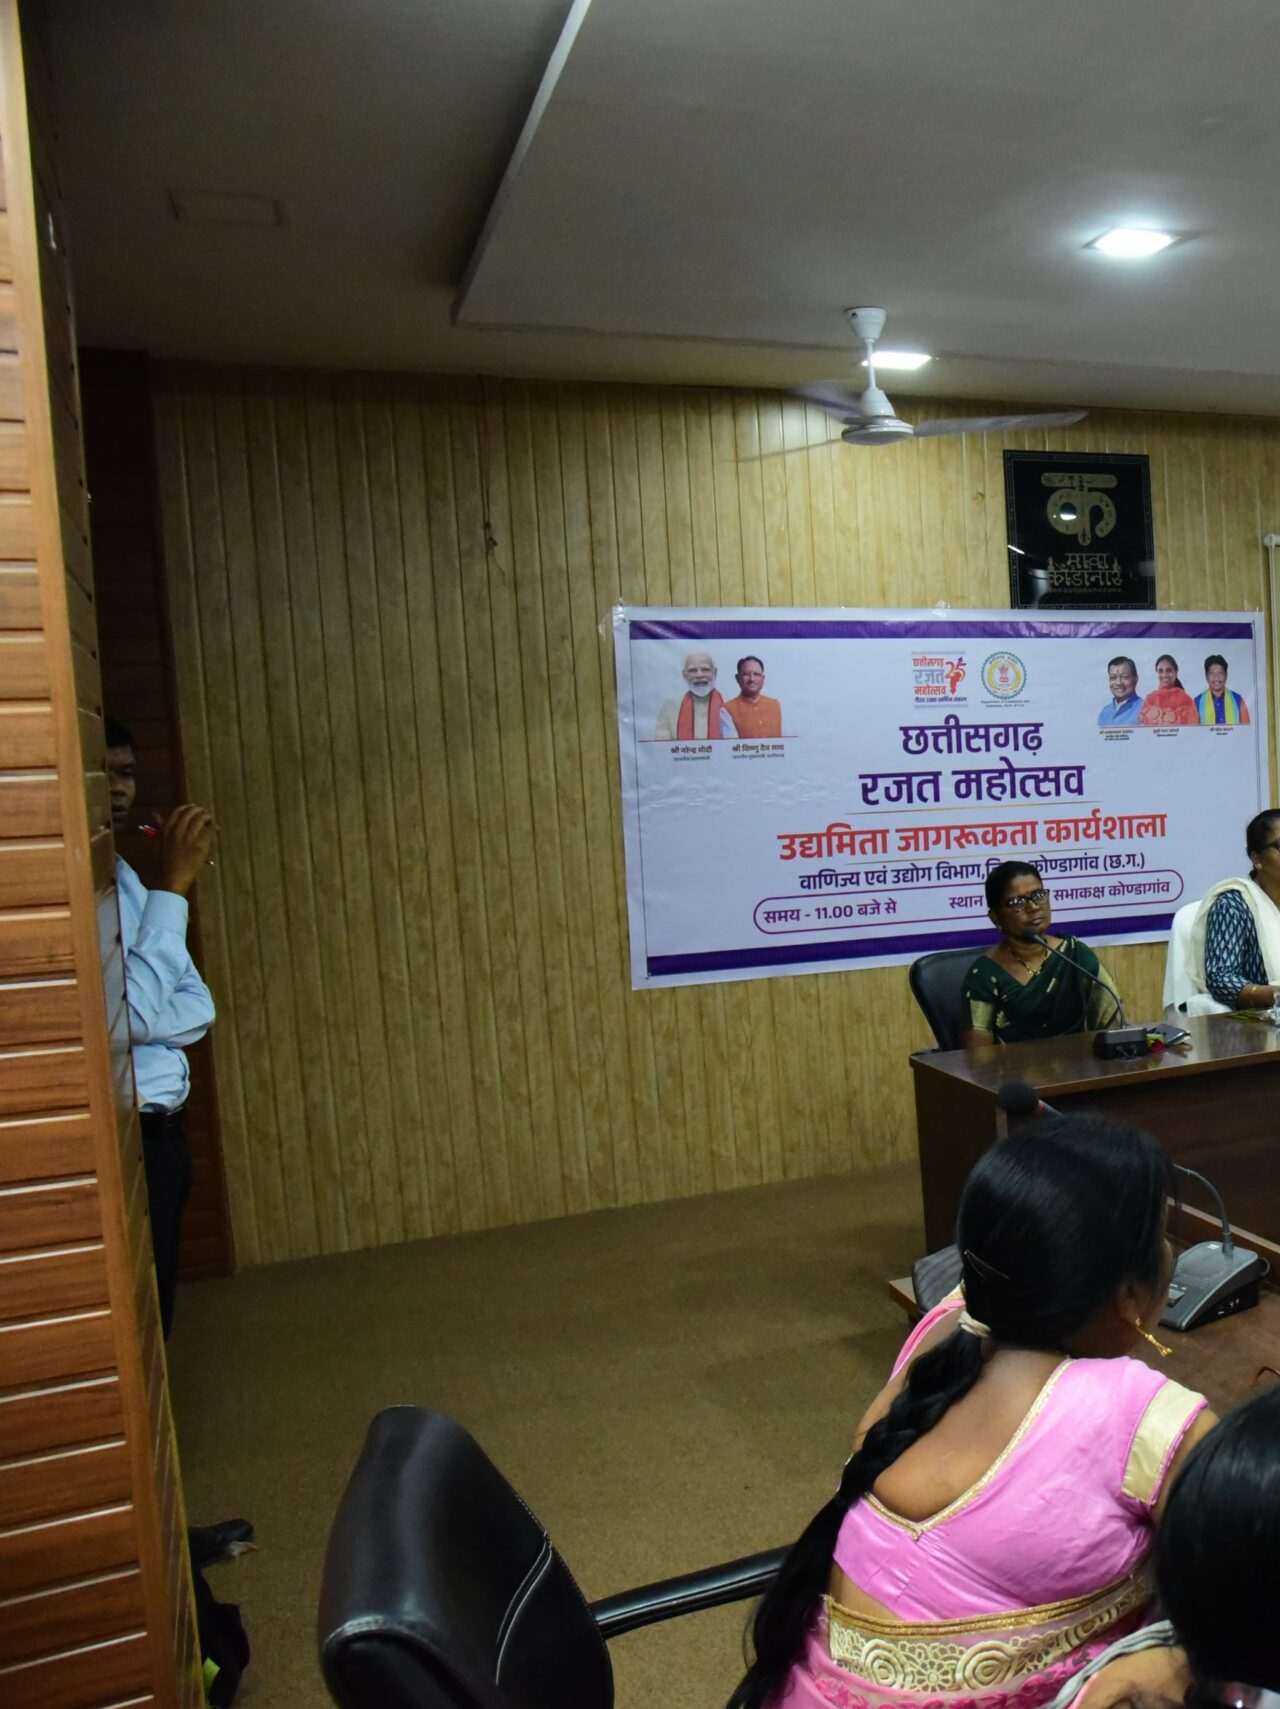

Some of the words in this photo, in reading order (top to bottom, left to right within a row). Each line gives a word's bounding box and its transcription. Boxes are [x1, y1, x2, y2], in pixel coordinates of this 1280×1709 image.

[900, 714, 1044, 756] छत्तीसगढ़
[858, 771, 942, 806] रजत
[952, 756, 1086, 801] महोत्सव
[777, 822, 889, 861] उद्यमिता
[895, 820, 1038, 852] जागरूकता
[1044, 808, 1167, 843] कार्यशाला
[799, 868, 860, 890] वाणिज्य
[864, 865, 887, 886] एवं
[891, 863, 932, 884] उद्योग
[1103, 852, 1145, 872] (छ.ग.)
[763, 909, 800, 924] समय
[815, 904, 854, 920] 11.00
[857, 898, 881, 916] बजे
[884, 897, 897, 915] से
[948, 895, 984, 909] स्थान
[1052, 884, 1105, 902] सभाकक्ष
[1108, 878, 1171, 897] कोण्डागांव
